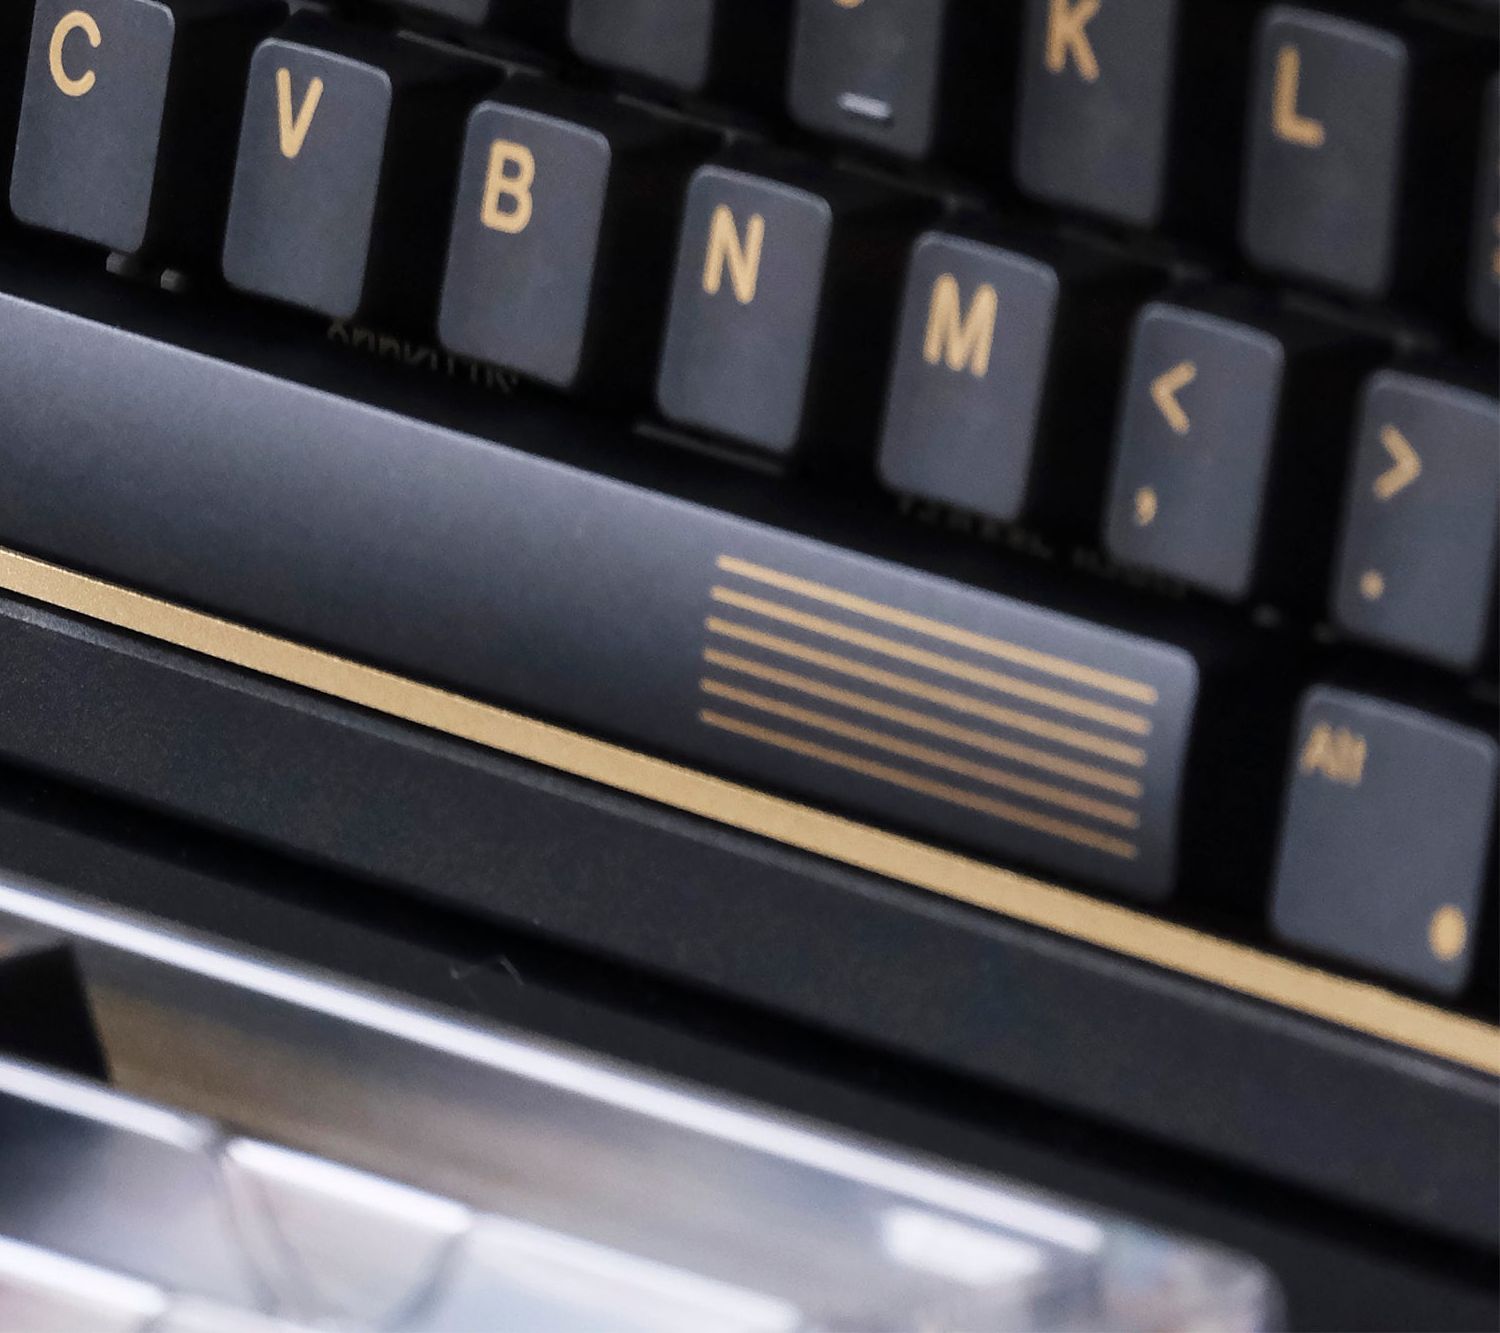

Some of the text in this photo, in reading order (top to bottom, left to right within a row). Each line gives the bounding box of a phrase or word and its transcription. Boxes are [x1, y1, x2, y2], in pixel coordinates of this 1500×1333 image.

[48, 9, 101, 97] C
[1273, 48, 1323, 145] L
[276, 68, 324, 158] V
[480, 139, 535, 233] B
[703, 205, 764, 303] N
[923, 274, 997, 376] M
[1149, 361, 1197, 434] <
[1373, 426, 1422, 500] >
